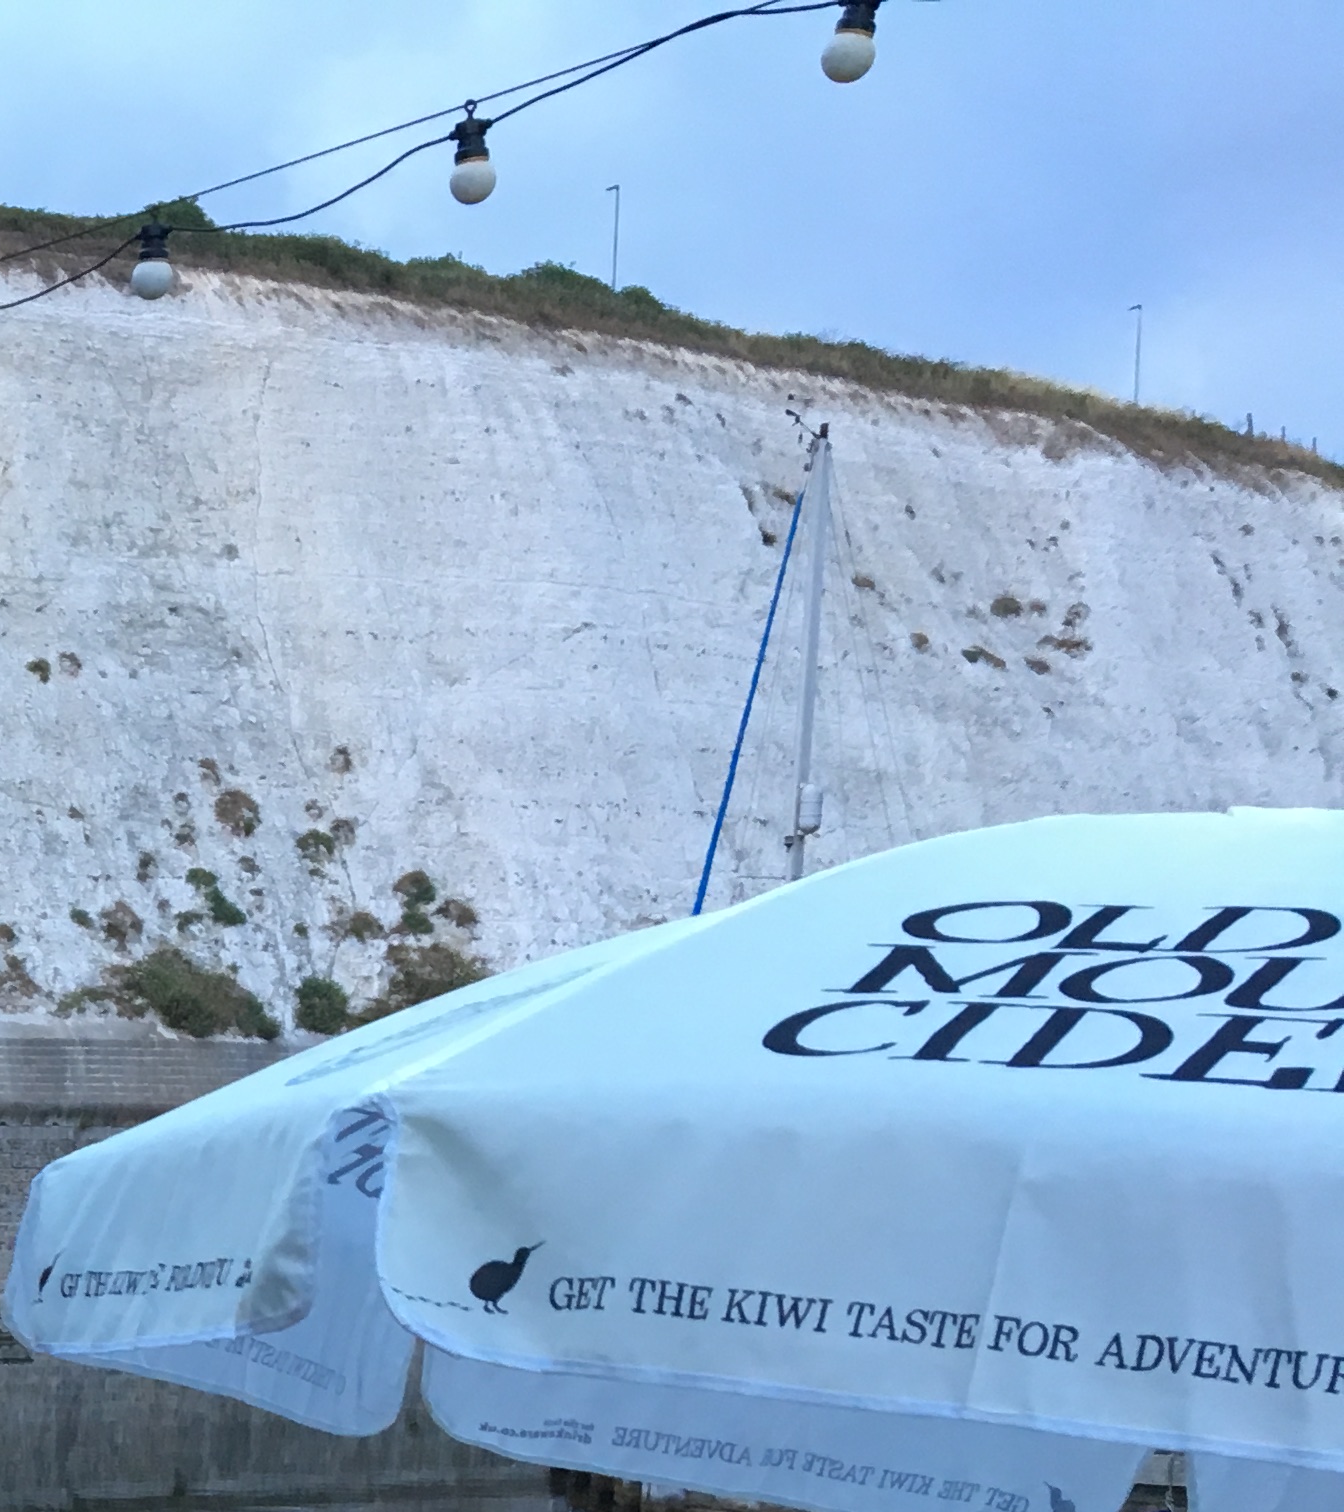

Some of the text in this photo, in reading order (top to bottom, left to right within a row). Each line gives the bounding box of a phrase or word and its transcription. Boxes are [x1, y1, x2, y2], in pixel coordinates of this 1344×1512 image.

[901, 900, 1342, 953] OLD
[761, 999, 1344, 1093] CIDE
[548, 1276, 616, 1312] GET
[628, 1277, 715, 1321] THE
[720, 1288, 835, 1334] KIWI
[845, 1301, 981, 1350] TASTE
[986, 1314, 1081, 1363] FOR
